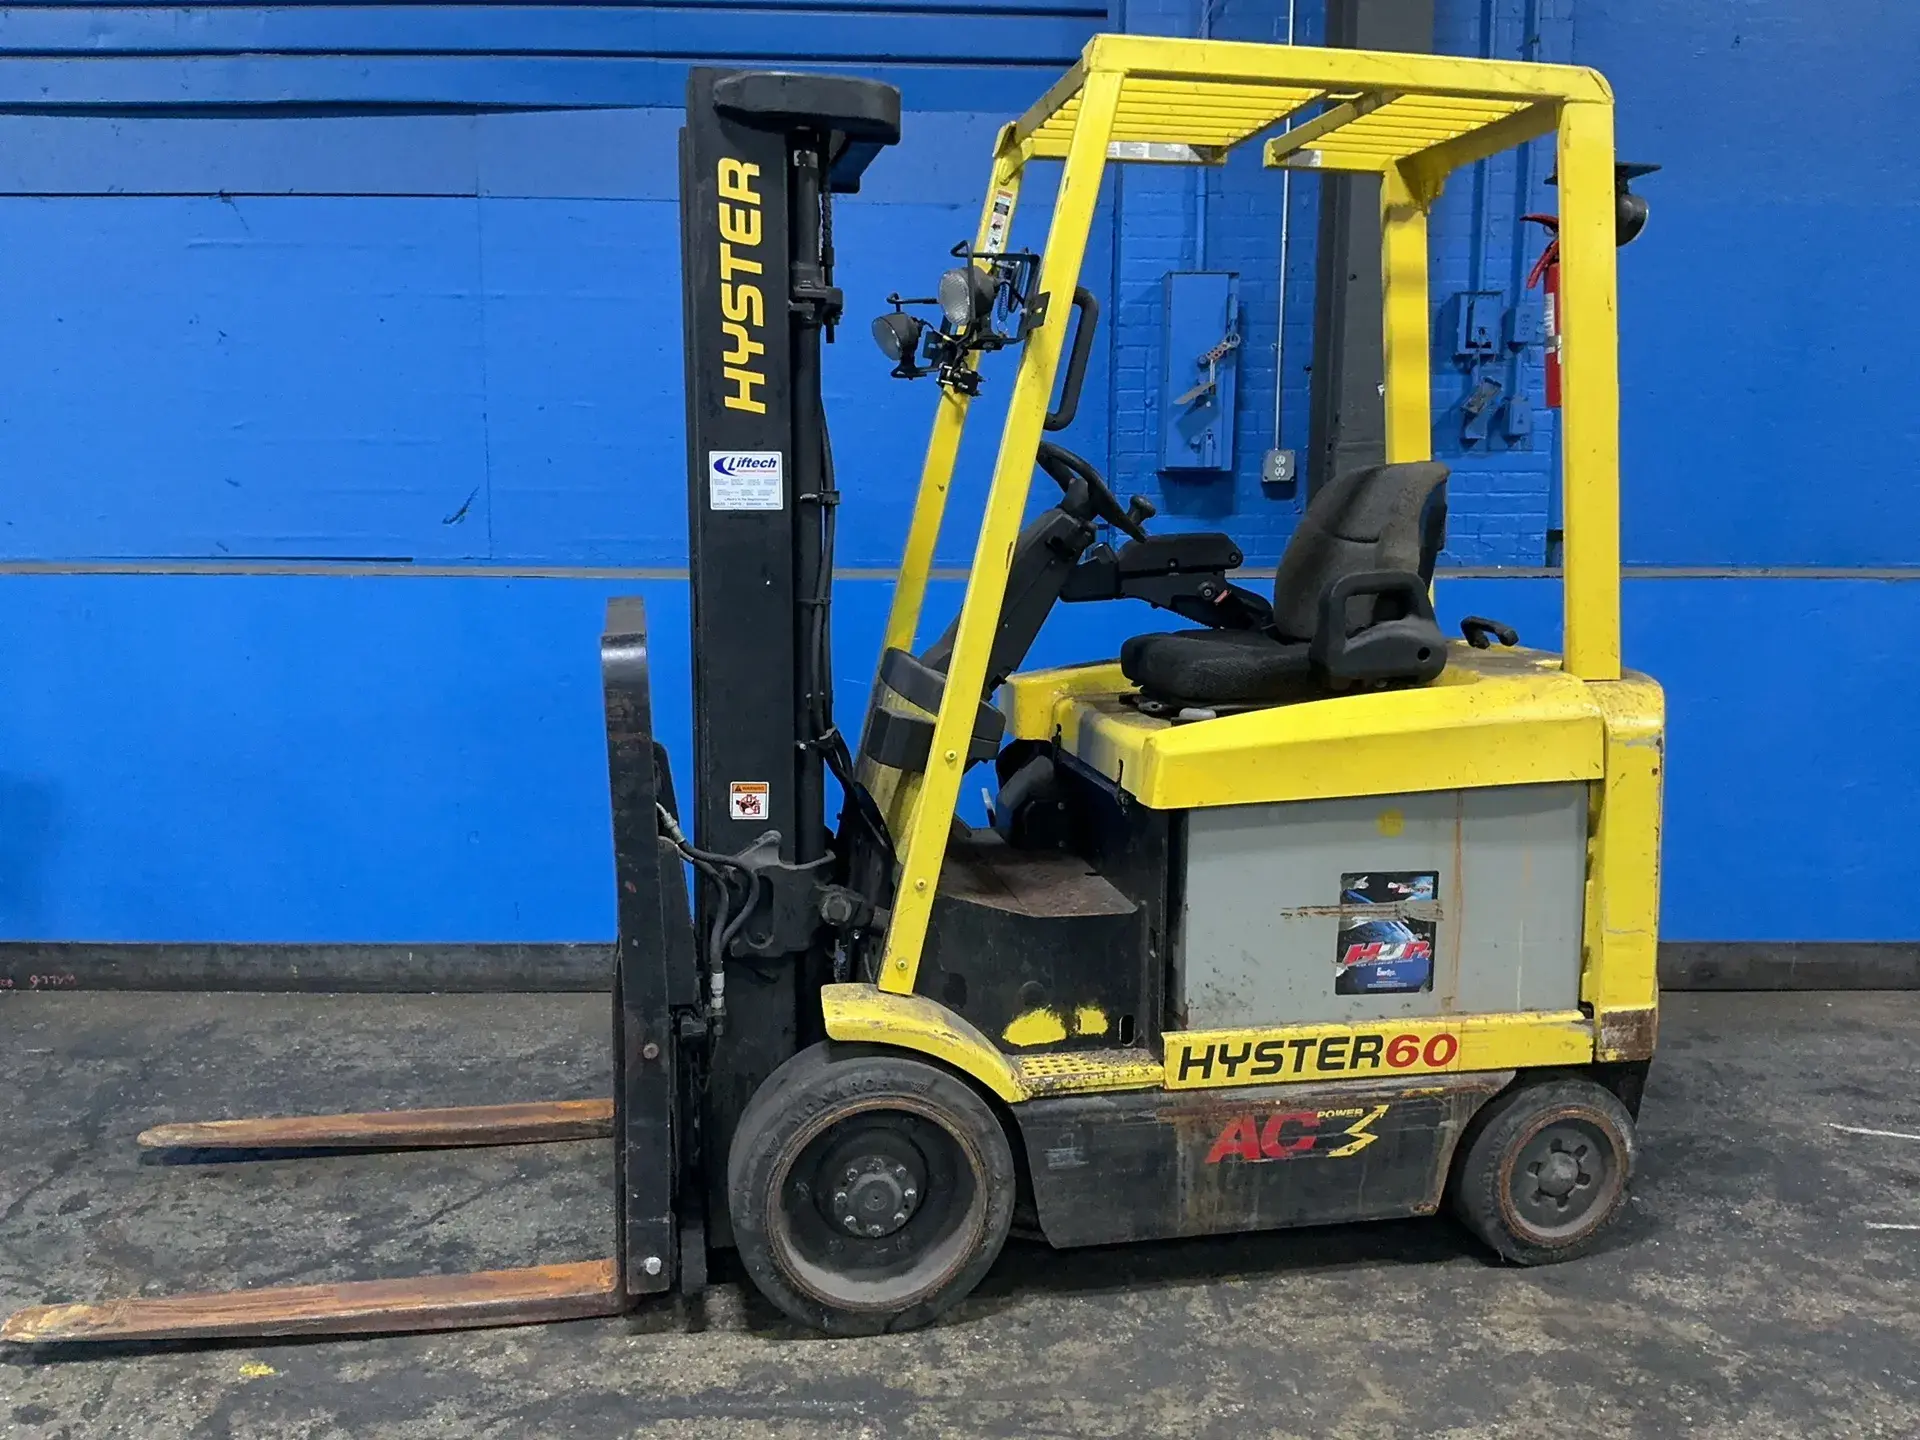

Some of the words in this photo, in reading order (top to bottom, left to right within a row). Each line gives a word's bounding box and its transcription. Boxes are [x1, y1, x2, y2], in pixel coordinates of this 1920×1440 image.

[717, 156, 766, 415] HYSTER
[727, 456, 777, 471] Liftech
[1204, 1111, 1321, 1164] AC
[1316, 1106, 1365, 1119] POWER
